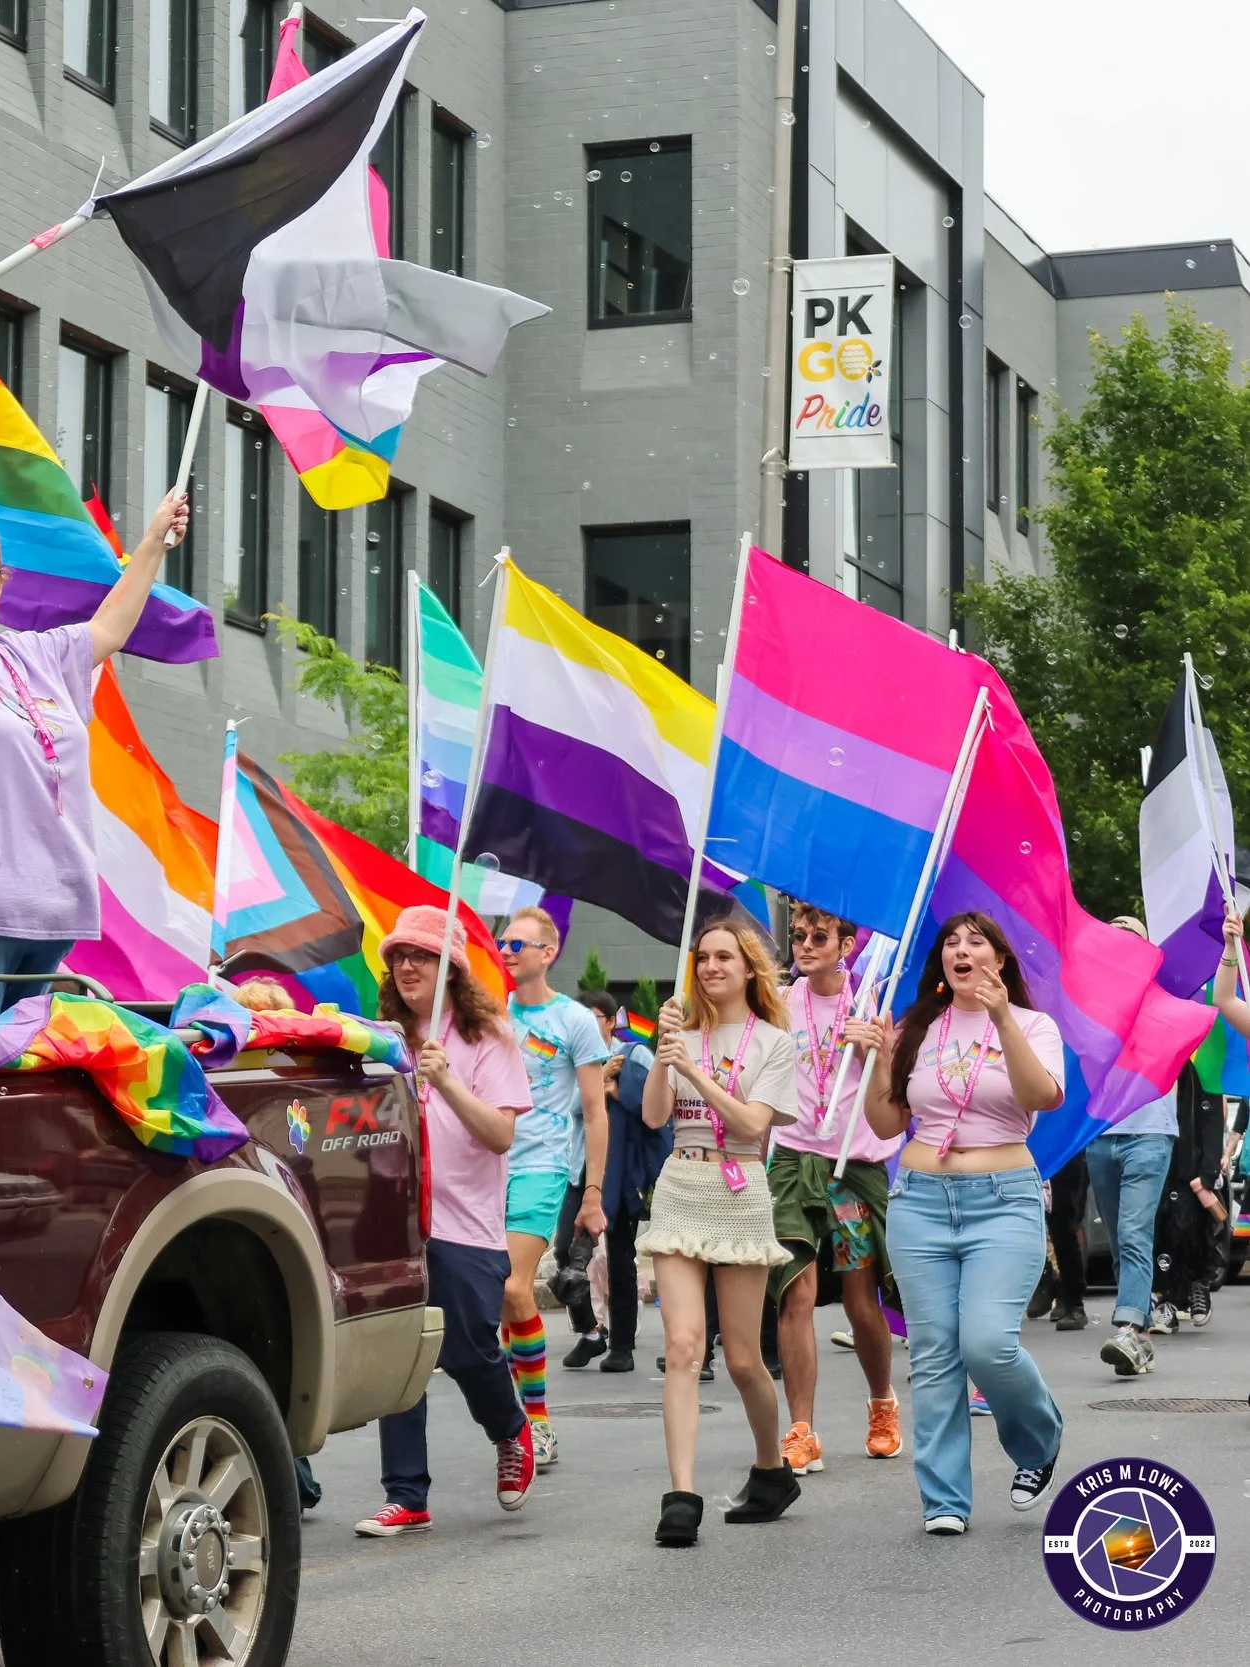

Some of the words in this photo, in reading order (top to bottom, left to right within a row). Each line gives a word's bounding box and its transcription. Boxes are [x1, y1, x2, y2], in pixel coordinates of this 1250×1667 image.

[804, 294, 874, 339] PK
[798, 338, 874, 383] GO
[795, 391, 882, 431] Pride
[325, 1093, 402, 1135] FX4
[321, 1136, 353, 1152] OFF
[357, 1130, 401, 1148] ROAD
